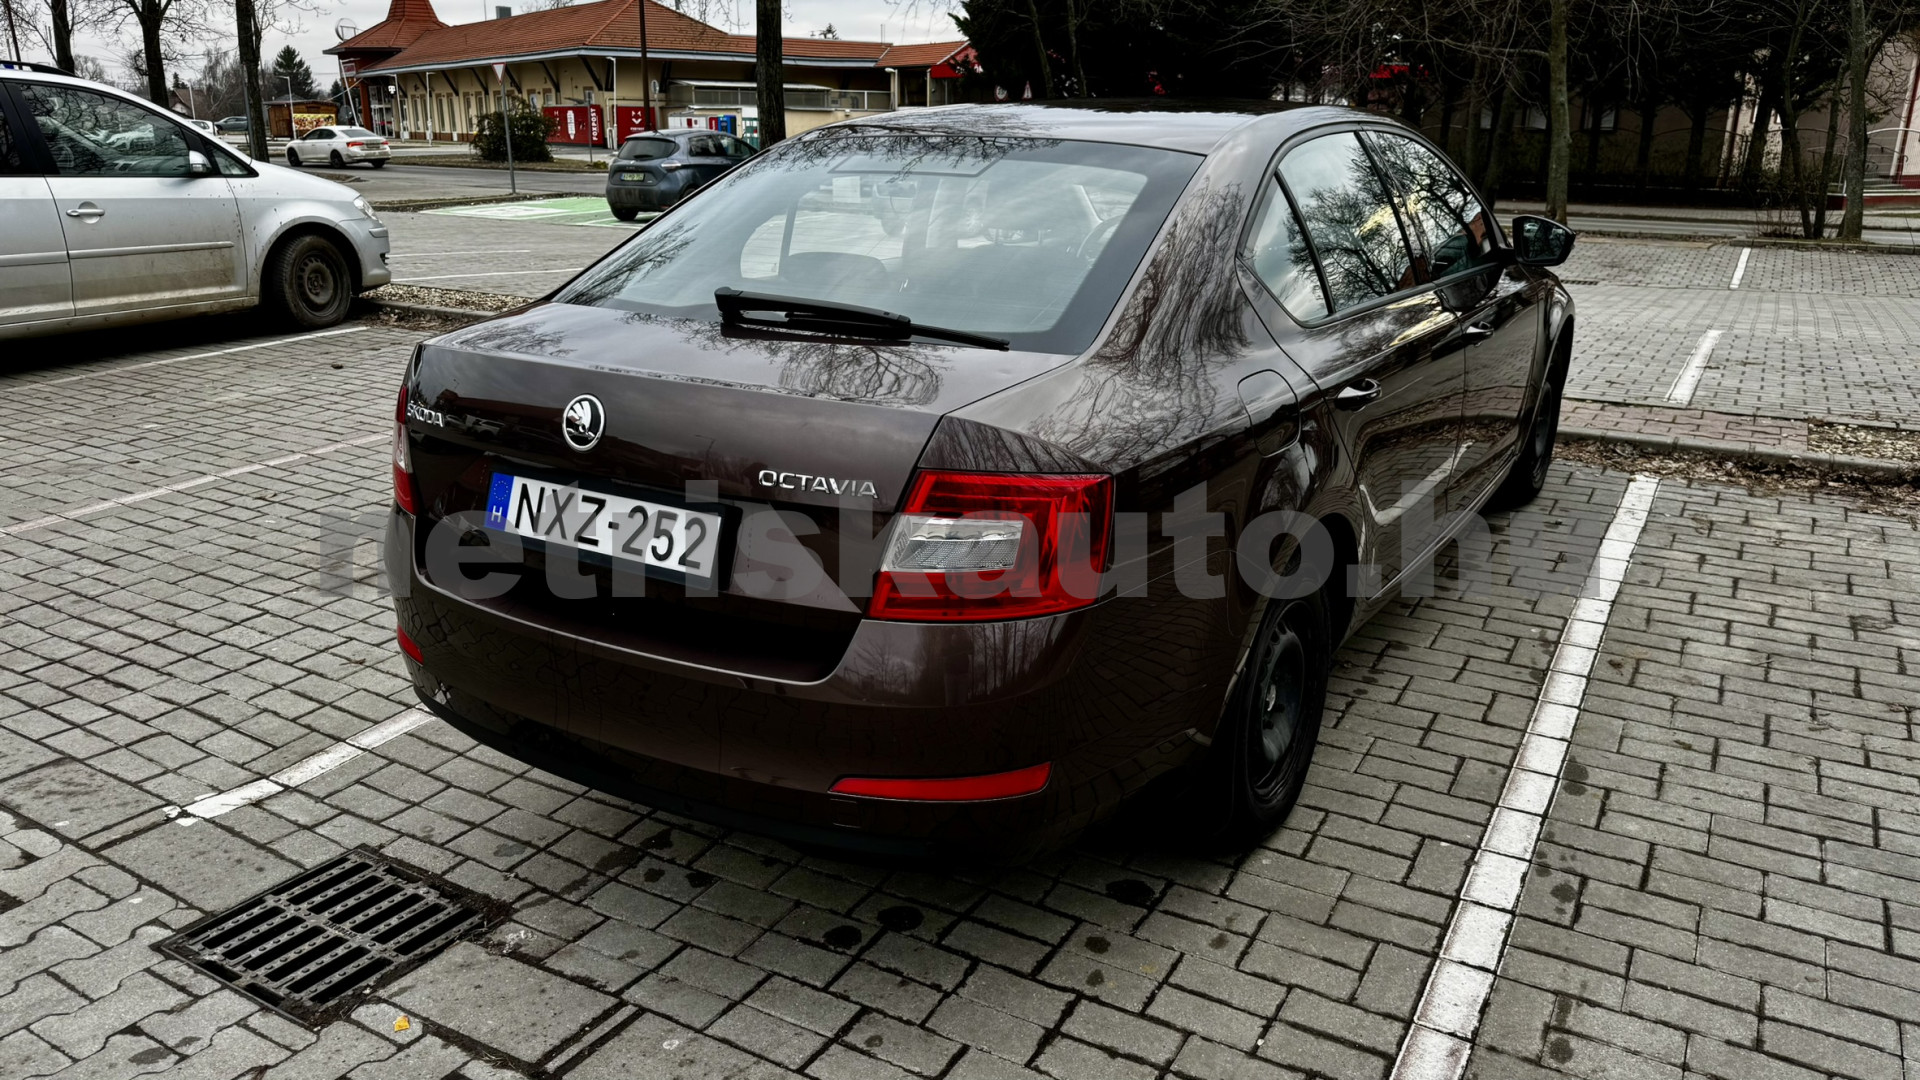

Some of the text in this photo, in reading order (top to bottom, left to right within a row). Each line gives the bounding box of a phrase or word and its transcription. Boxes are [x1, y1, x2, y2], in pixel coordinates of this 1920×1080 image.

[590, 107, 599, 141] FOXPOST
[758, 469, 879, 499] OCTAVIA
[490, 504, 504, 524] H
[514, 482, 708, 570] NXZ-252
